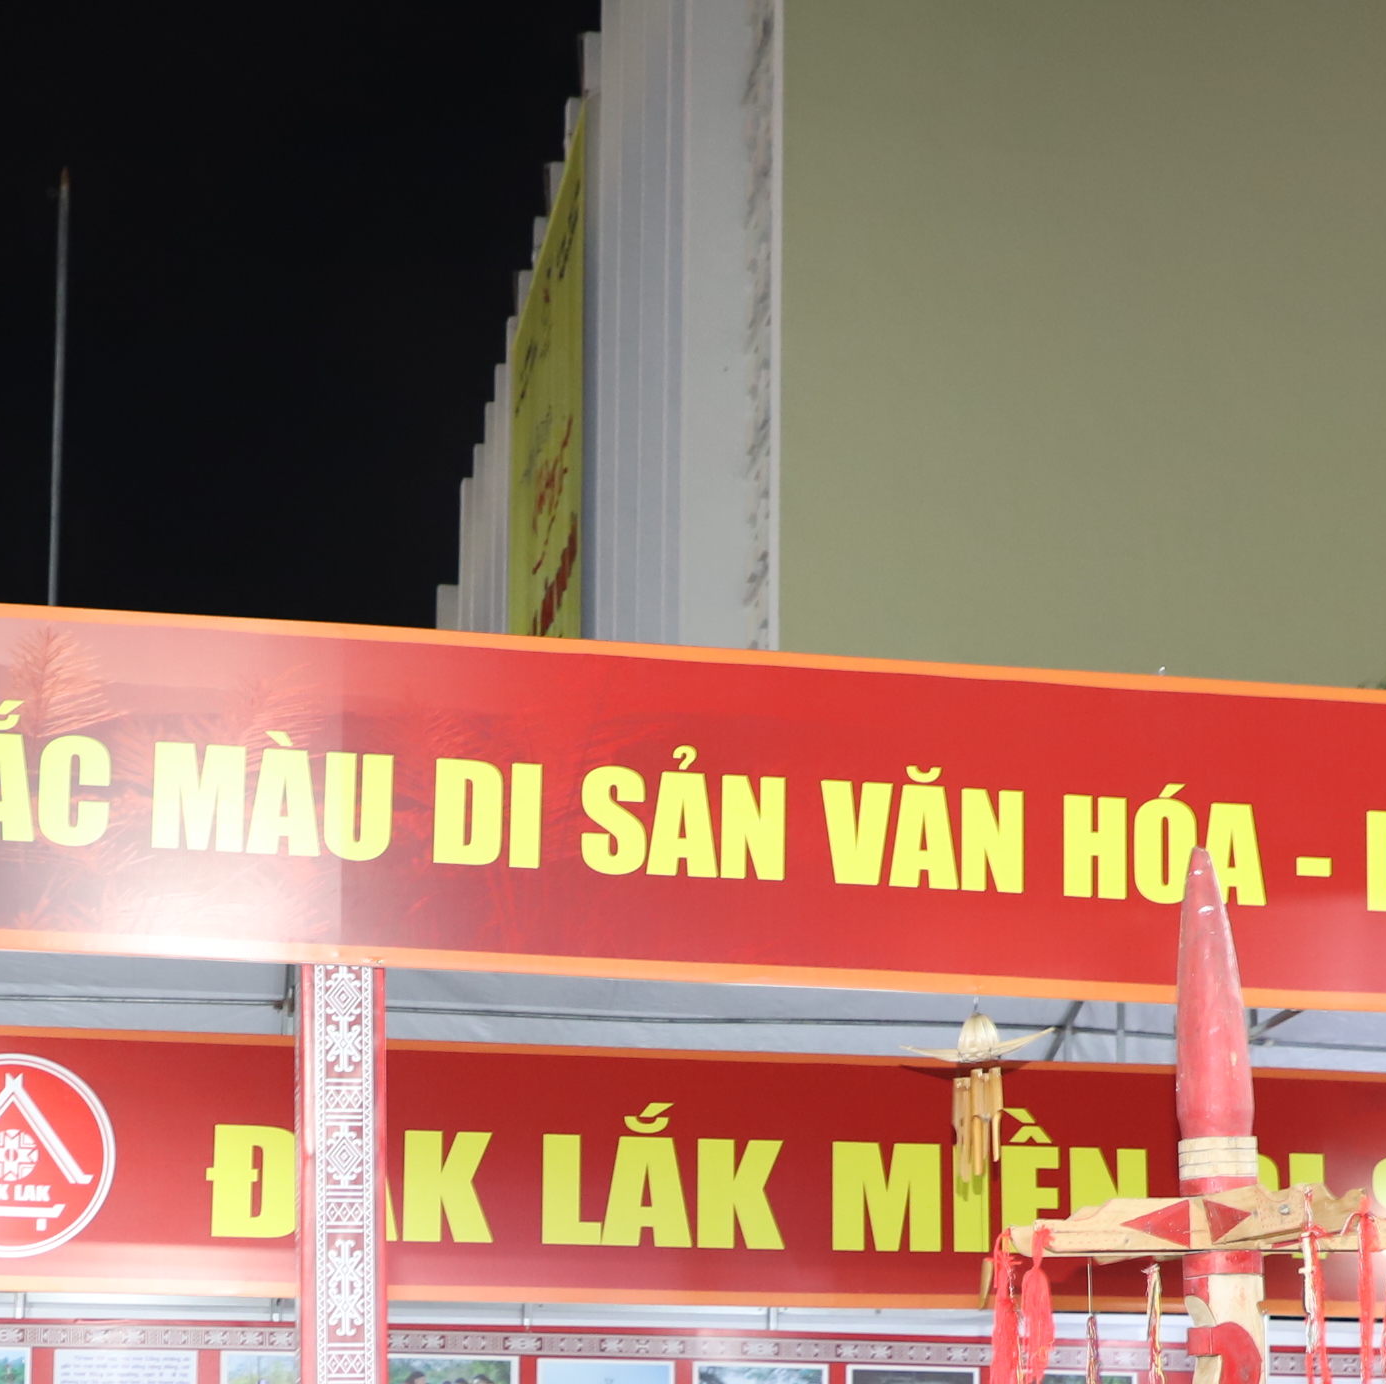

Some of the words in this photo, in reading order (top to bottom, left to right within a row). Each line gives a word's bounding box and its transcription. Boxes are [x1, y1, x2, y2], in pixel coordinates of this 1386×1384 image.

[151, 730, 394, 862] MÀU
[432, 757, 544, 869] DI
[580, 744, 787, 881] SẢN
[820, 764, 1025, 894] VĂN
[1062, 783, 1267, 907] HÓA
[1295, 855, 1332, 878] -
[14, 1184, 52, 1202] LAK
[206, 1123, 494, 1244] ĐK
[540, 1101, 785, 1251] LẮK
